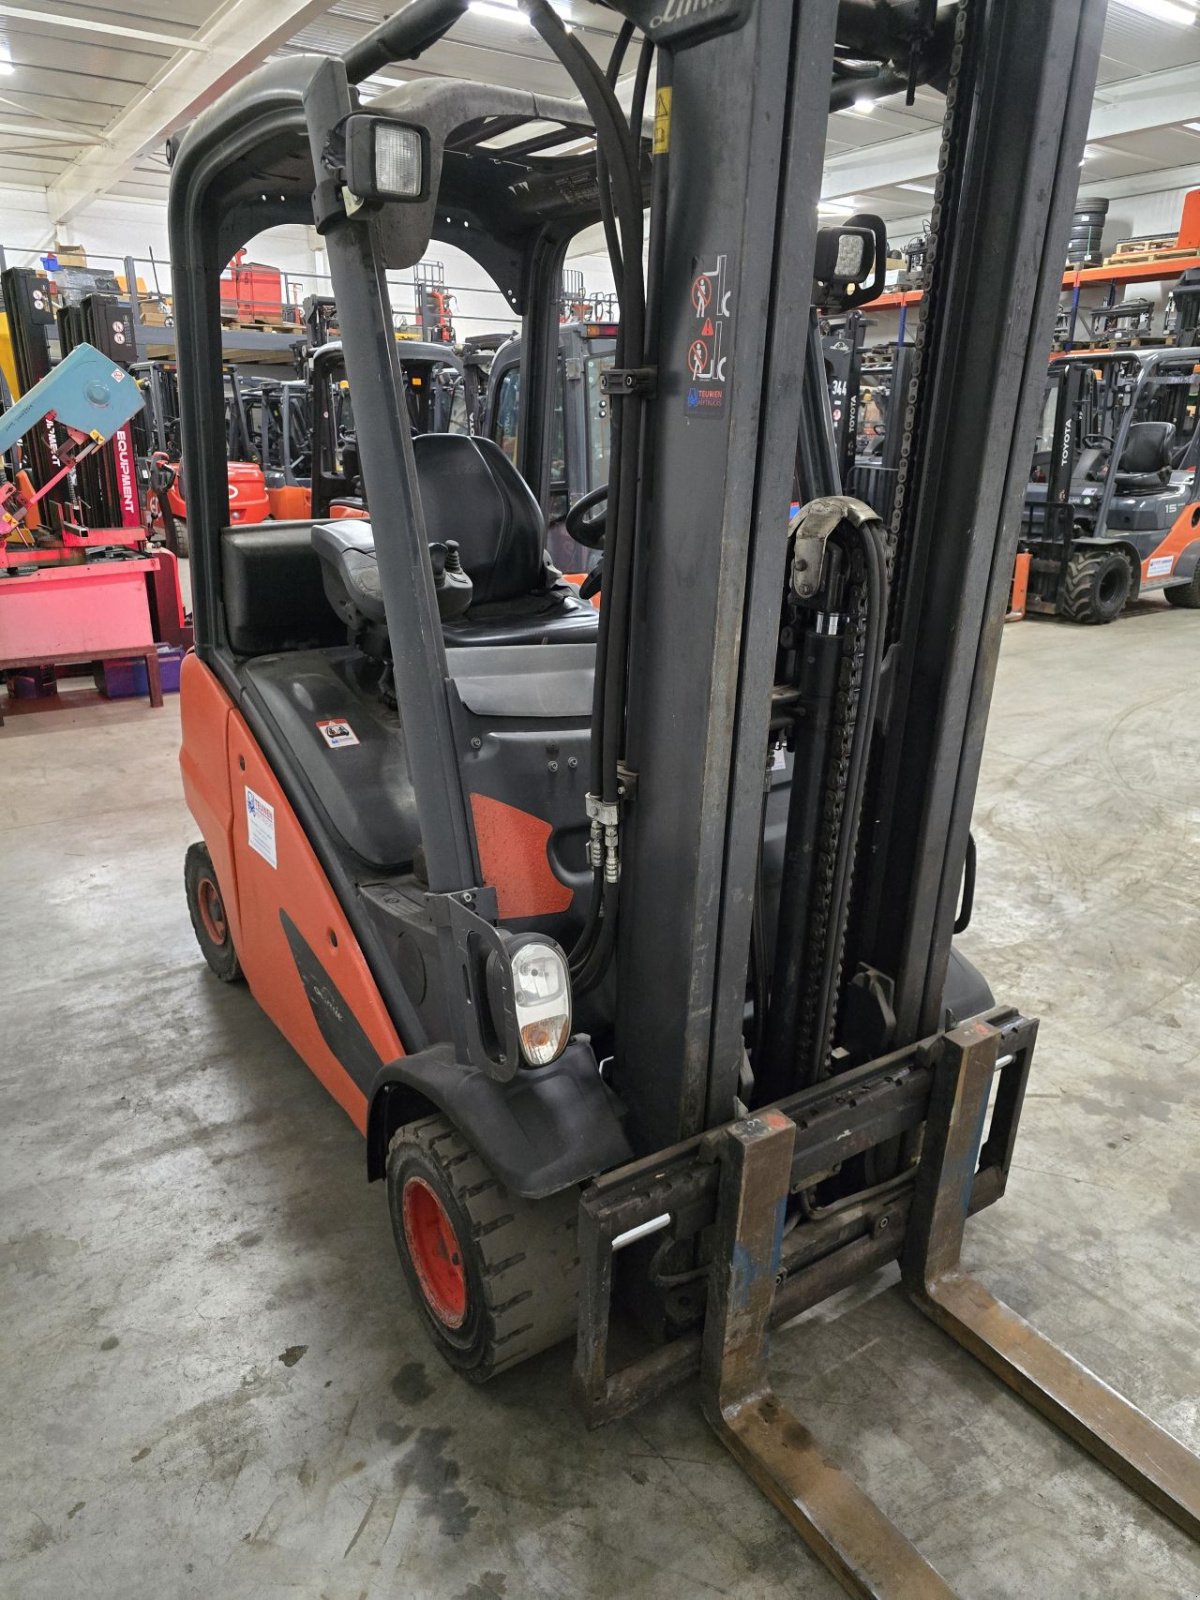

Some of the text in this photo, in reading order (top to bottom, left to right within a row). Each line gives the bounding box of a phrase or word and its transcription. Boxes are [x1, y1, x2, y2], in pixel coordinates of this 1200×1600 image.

[832, 380, 847, 396] 344
[848, 395, 857, 432] TOYOTA
[1061, 418, 1072, 466] TOYOTA
[116, 430, 135, 514] EQUIPMENT
[1165, 504, 1177, 513] 15
